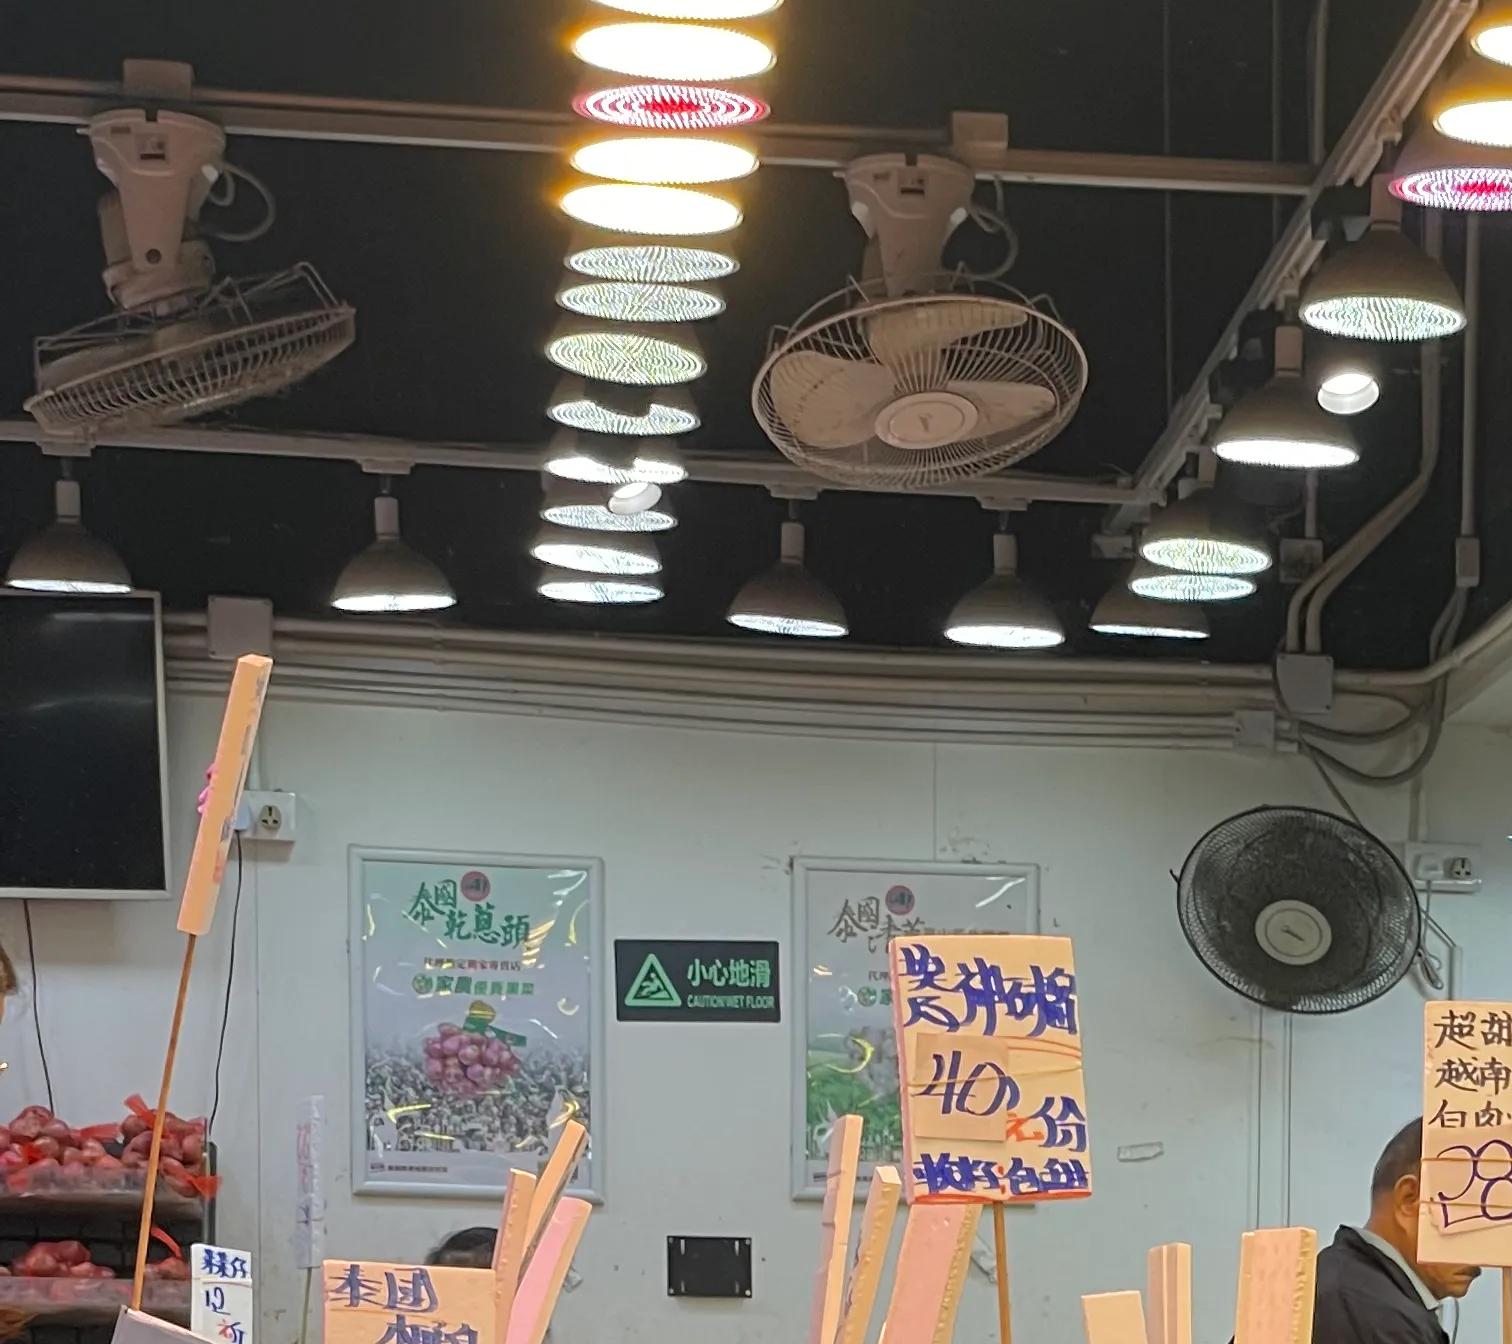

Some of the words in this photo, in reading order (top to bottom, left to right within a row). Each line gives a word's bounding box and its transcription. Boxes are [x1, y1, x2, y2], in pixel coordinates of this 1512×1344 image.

[687, 958, 771, 988] 小心地滑
[746, 995, 775, 1008] FLOOR
[911, 1050, 1021, 1116] 40
[1434, 1057, 1512, 1096] 越南
